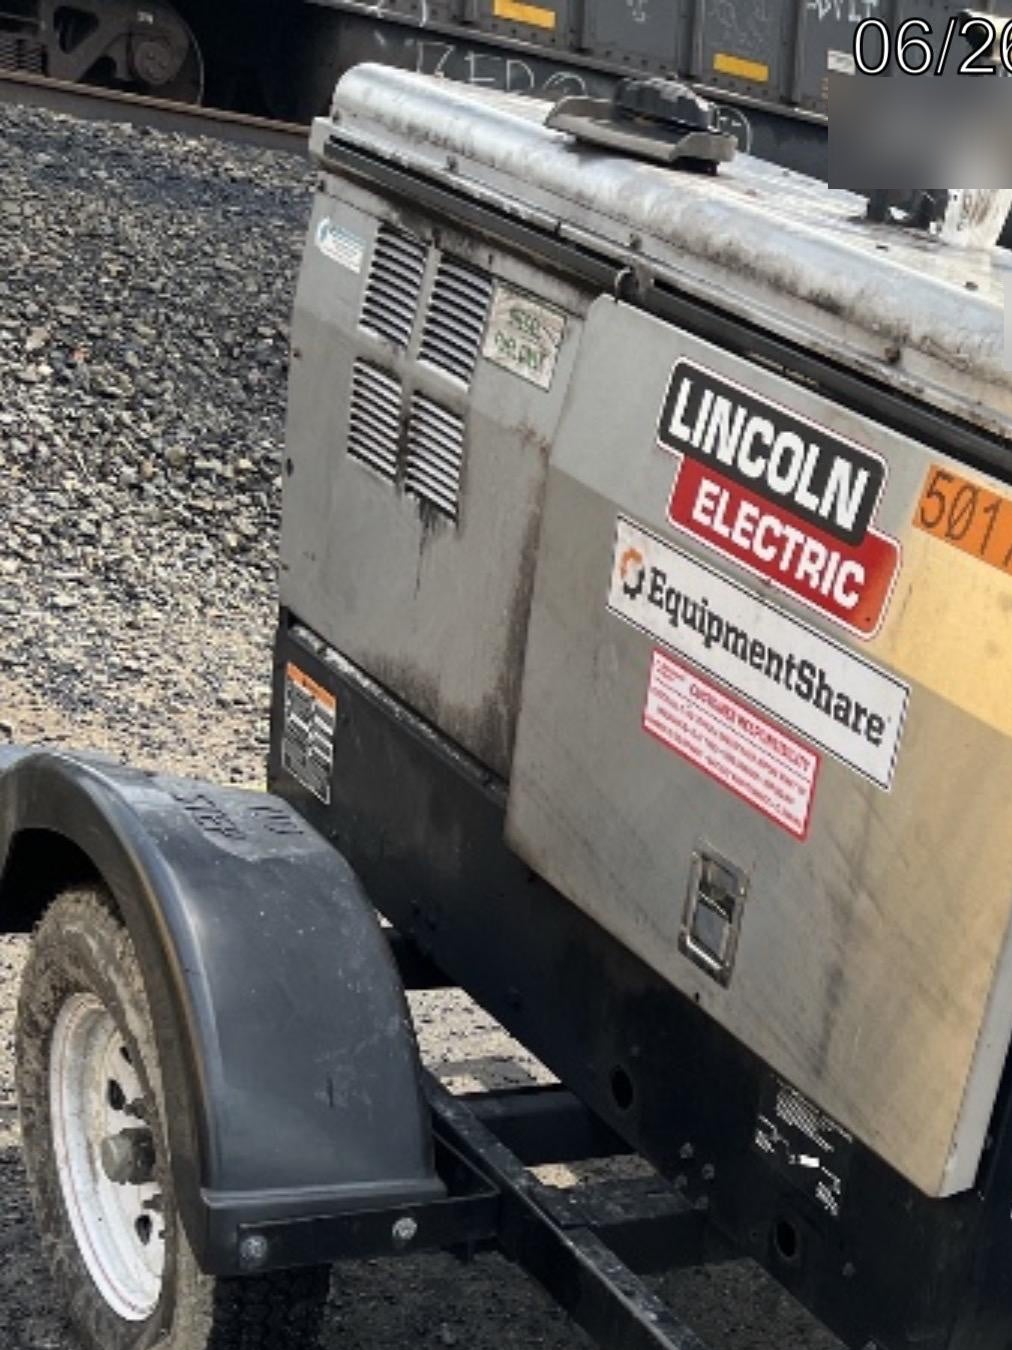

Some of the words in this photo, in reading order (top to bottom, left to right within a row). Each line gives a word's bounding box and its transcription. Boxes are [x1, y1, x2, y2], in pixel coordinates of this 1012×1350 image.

[668, 377, 871, 532] LINCOLN
[692, 476, 866, 610] ELECTRIC
[647, 566, 886, 746] EquipmentShare
